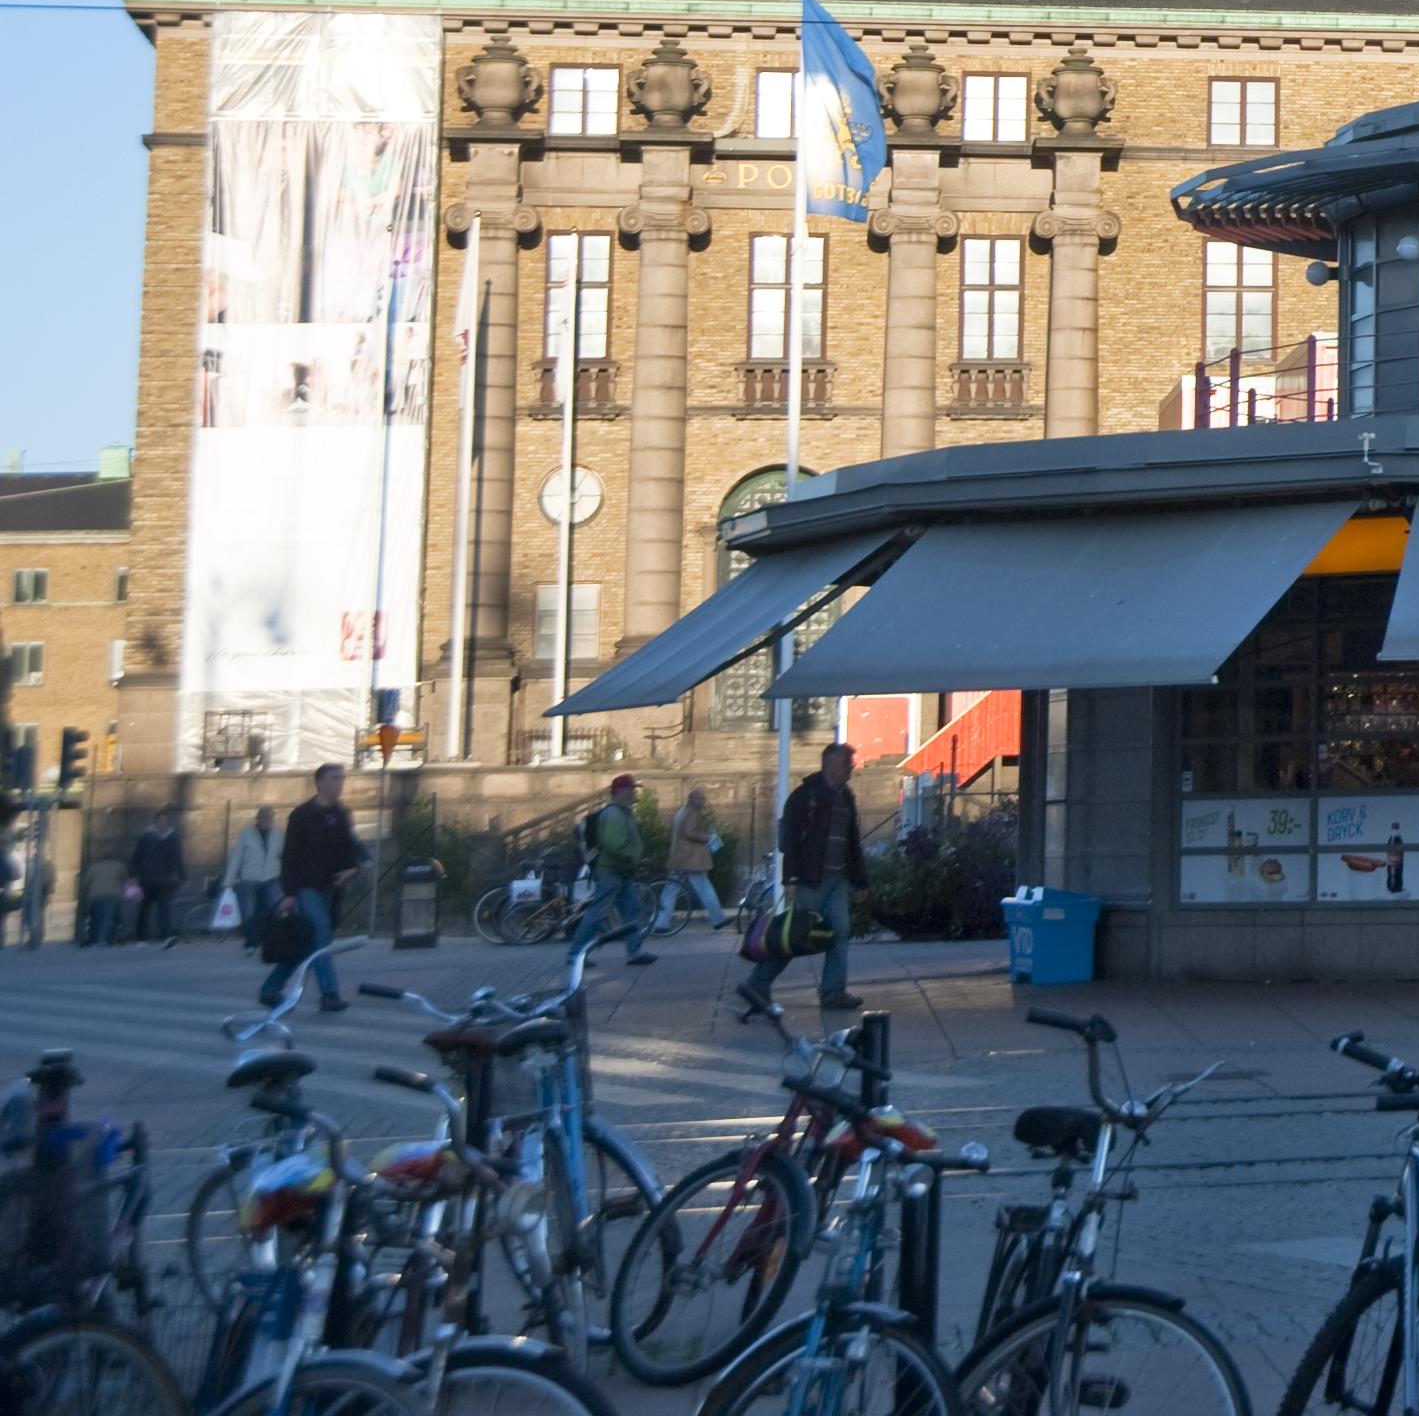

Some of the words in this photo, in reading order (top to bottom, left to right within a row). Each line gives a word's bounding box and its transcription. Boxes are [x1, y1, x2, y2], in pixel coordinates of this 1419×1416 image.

[1267, 809, 1302, 835] 39:-
[1327, 806, 1356, 825] KORV
[1327, 821, 1365, 843] DRYCK
